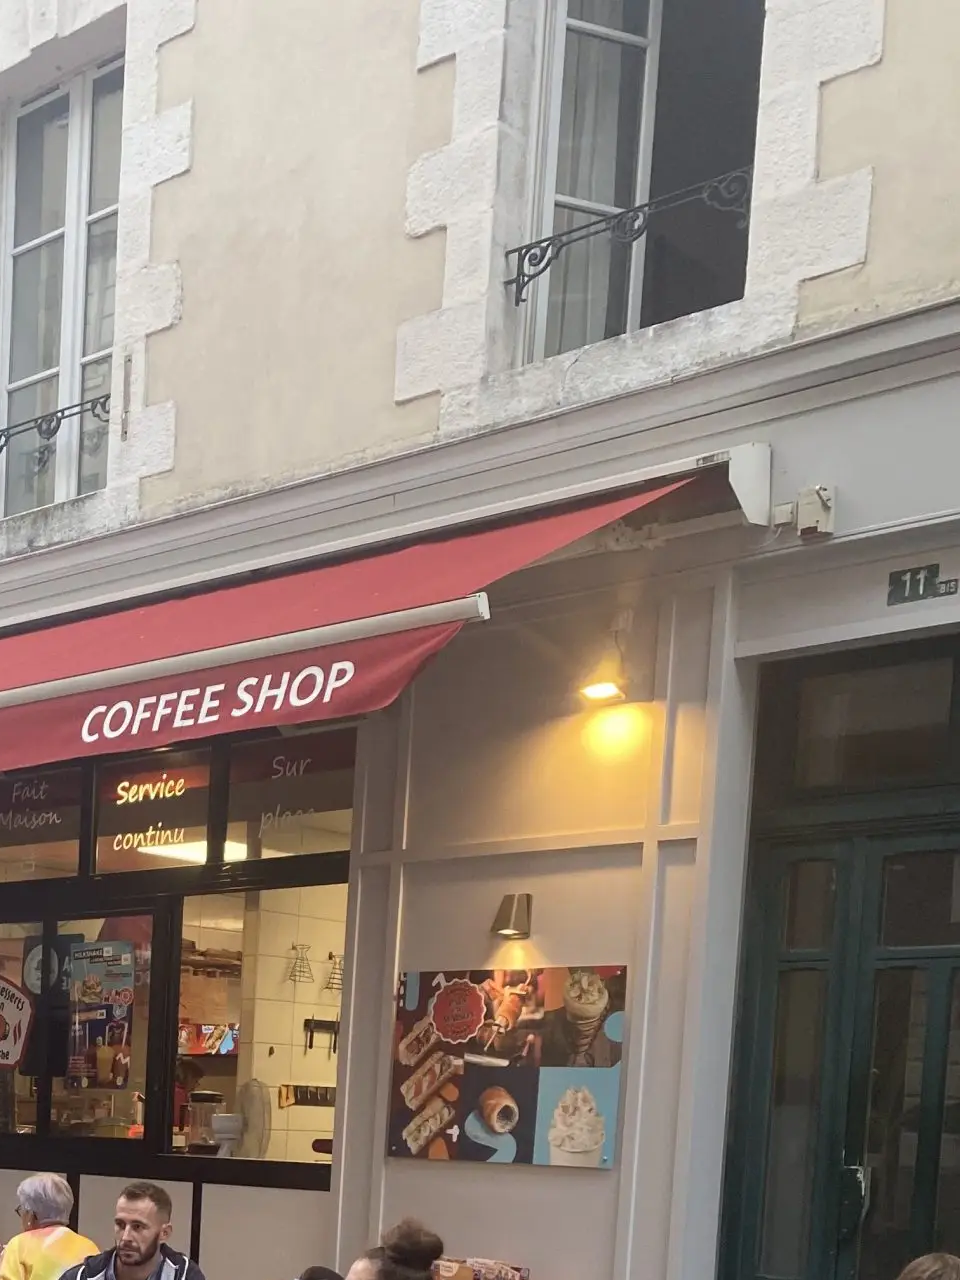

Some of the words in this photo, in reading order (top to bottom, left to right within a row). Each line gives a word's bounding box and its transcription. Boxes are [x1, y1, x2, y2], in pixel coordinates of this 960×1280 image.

[901, 568, 928, 597] 11
[81, 683, 225, 744] COFFEE
[230, 660, 355, 718] SHOP
[271, 755, 313, 779] Sur
[11, 780, 50, 803] Fait
[116, 773, 186, 806] Service
[113, 821, 185, 851] continu
